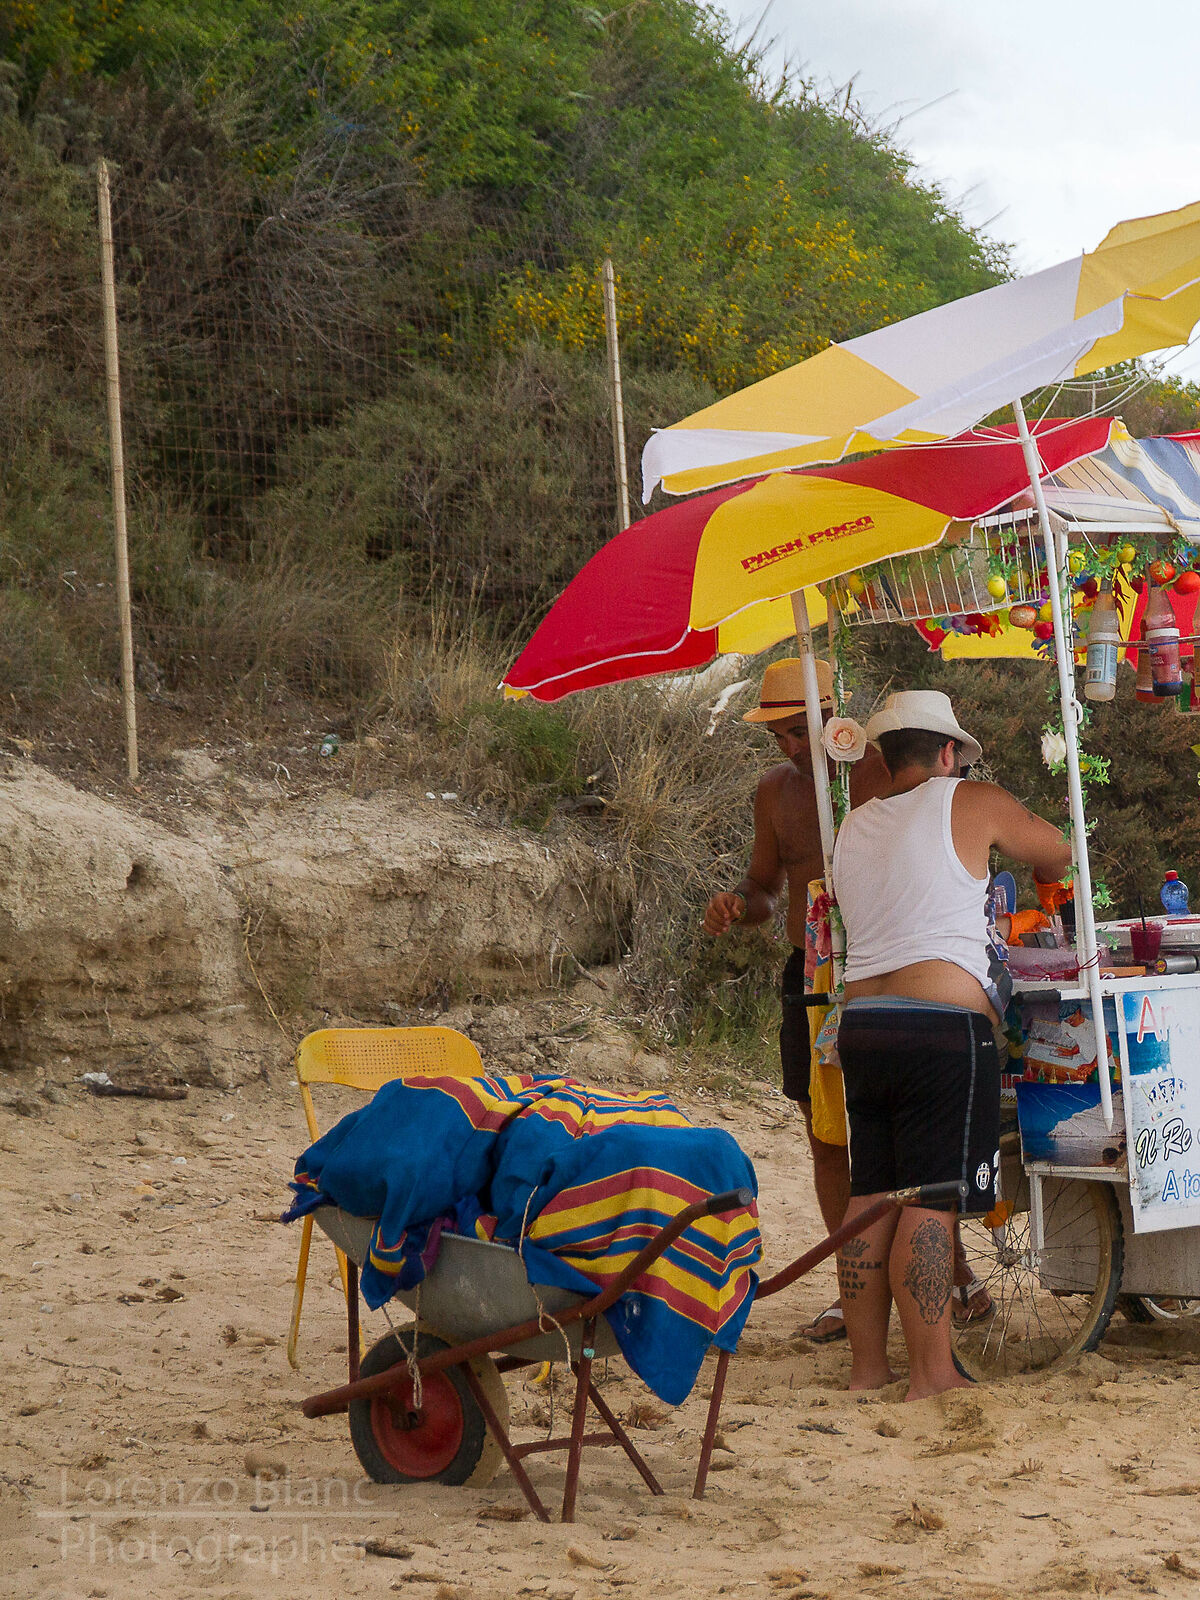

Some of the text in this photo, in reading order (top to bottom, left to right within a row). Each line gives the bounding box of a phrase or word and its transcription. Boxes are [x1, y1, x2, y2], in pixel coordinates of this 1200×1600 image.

[1135, 1127, 1158, 1169] Il
[1161, 1117, 1193, 1161] Re
[1161, 1169, 1180, 1202] A
